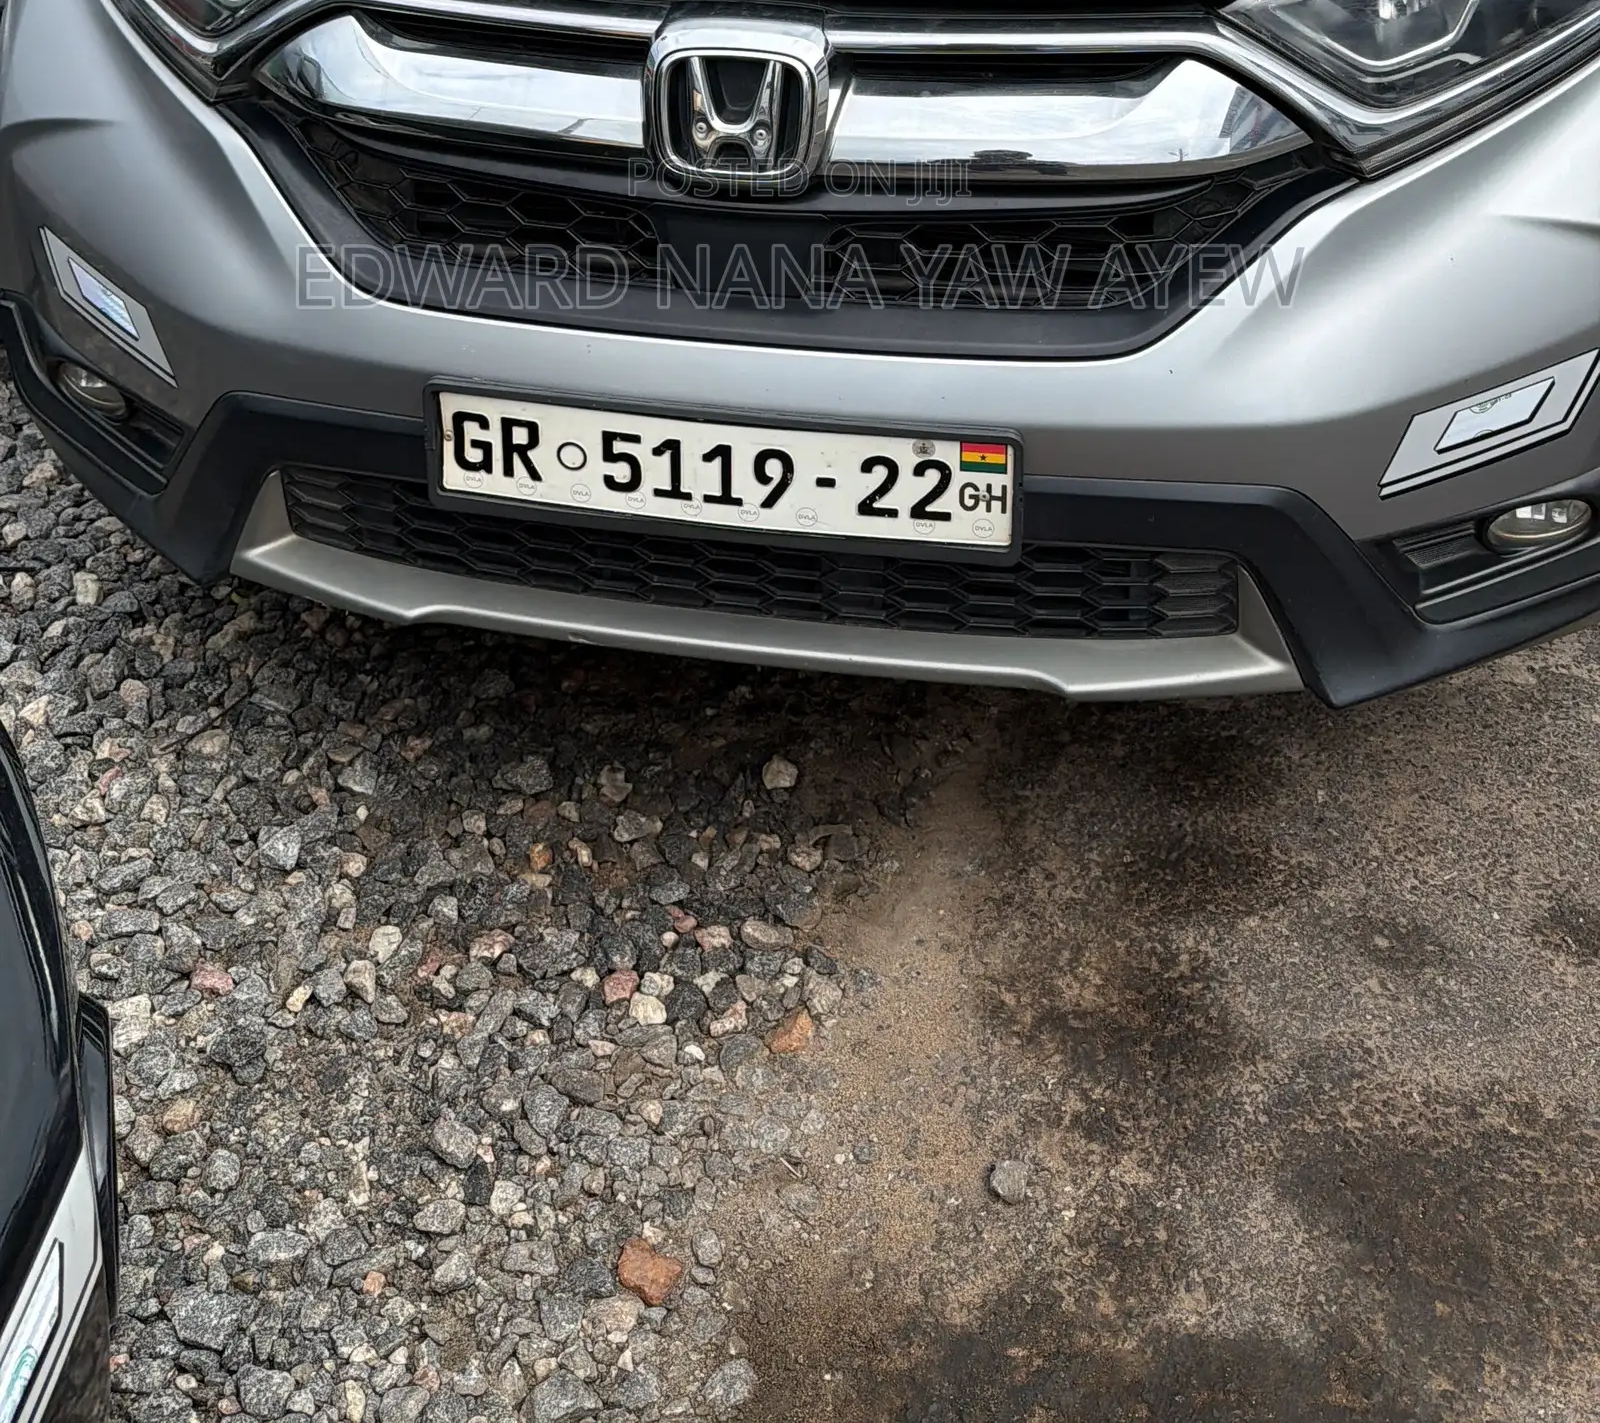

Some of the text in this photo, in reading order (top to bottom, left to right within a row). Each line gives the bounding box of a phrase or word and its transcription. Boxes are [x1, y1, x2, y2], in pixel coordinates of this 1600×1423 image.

[452, 410, 543, 482] GR
[466, 475, 482, 483] DVLA
[519, 482, 536, 490] DVLA
[572, 489, 590, 497] DVLA
[627, 496, 645, 504] DVLA
[798, 513, 816, 521] DVLA
[958, 481, 1008, 515] GH
